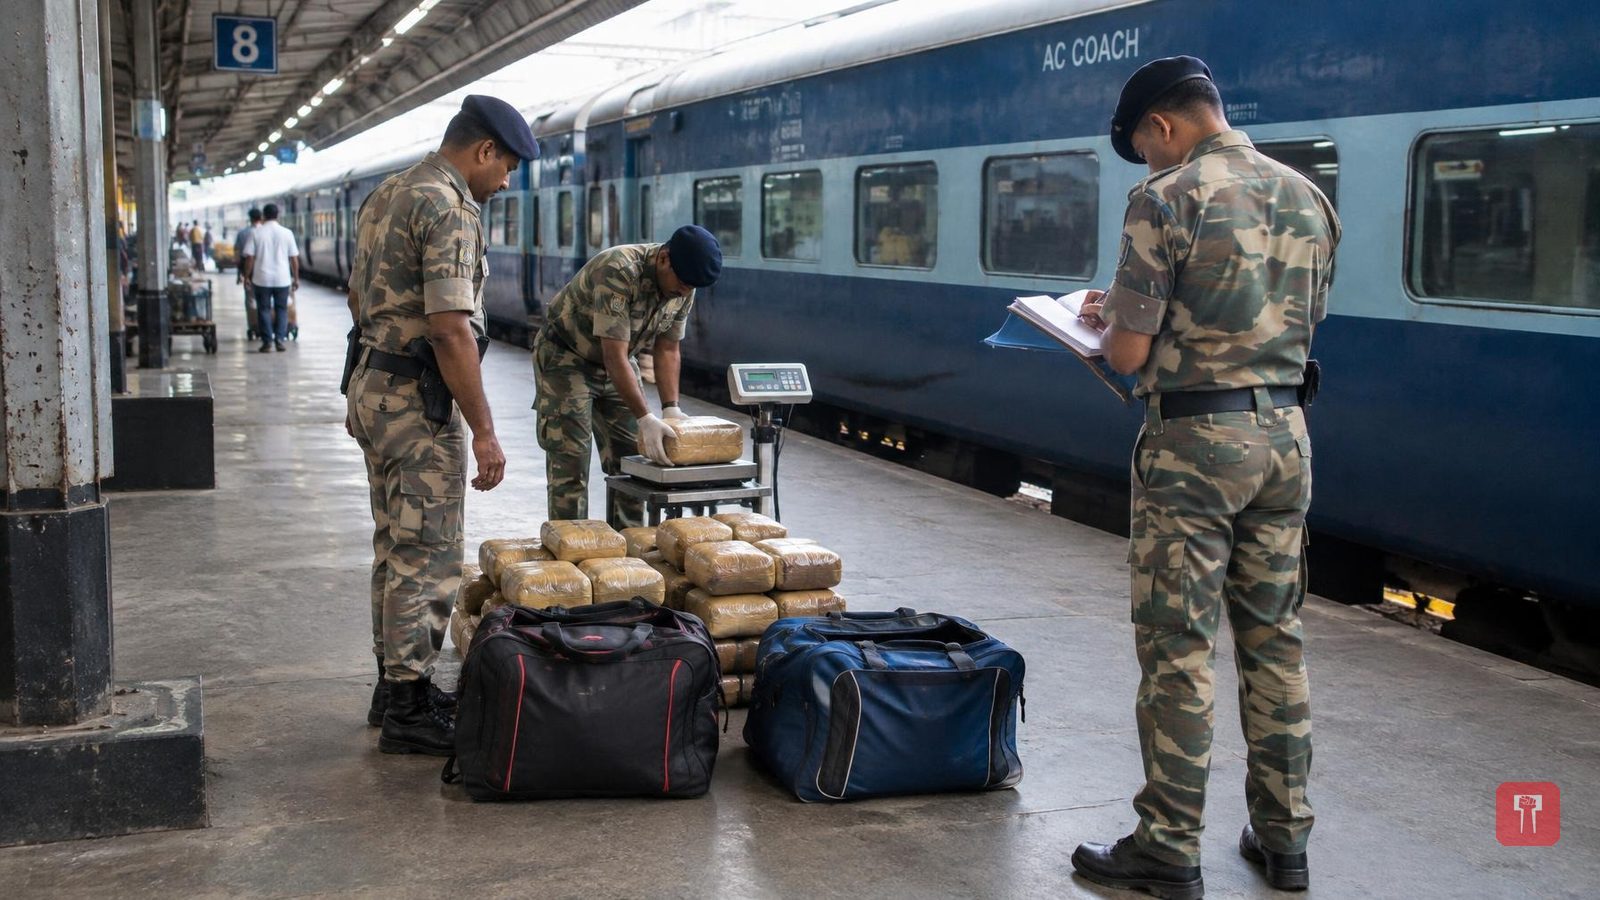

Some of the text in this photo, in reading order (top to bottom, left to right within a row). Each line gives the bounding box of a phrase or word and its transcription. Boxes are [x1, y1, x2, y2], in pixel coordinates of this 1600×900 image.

[231, 25, 260, 64] 8
[1042, 28, 1139, 72] AC COACH
